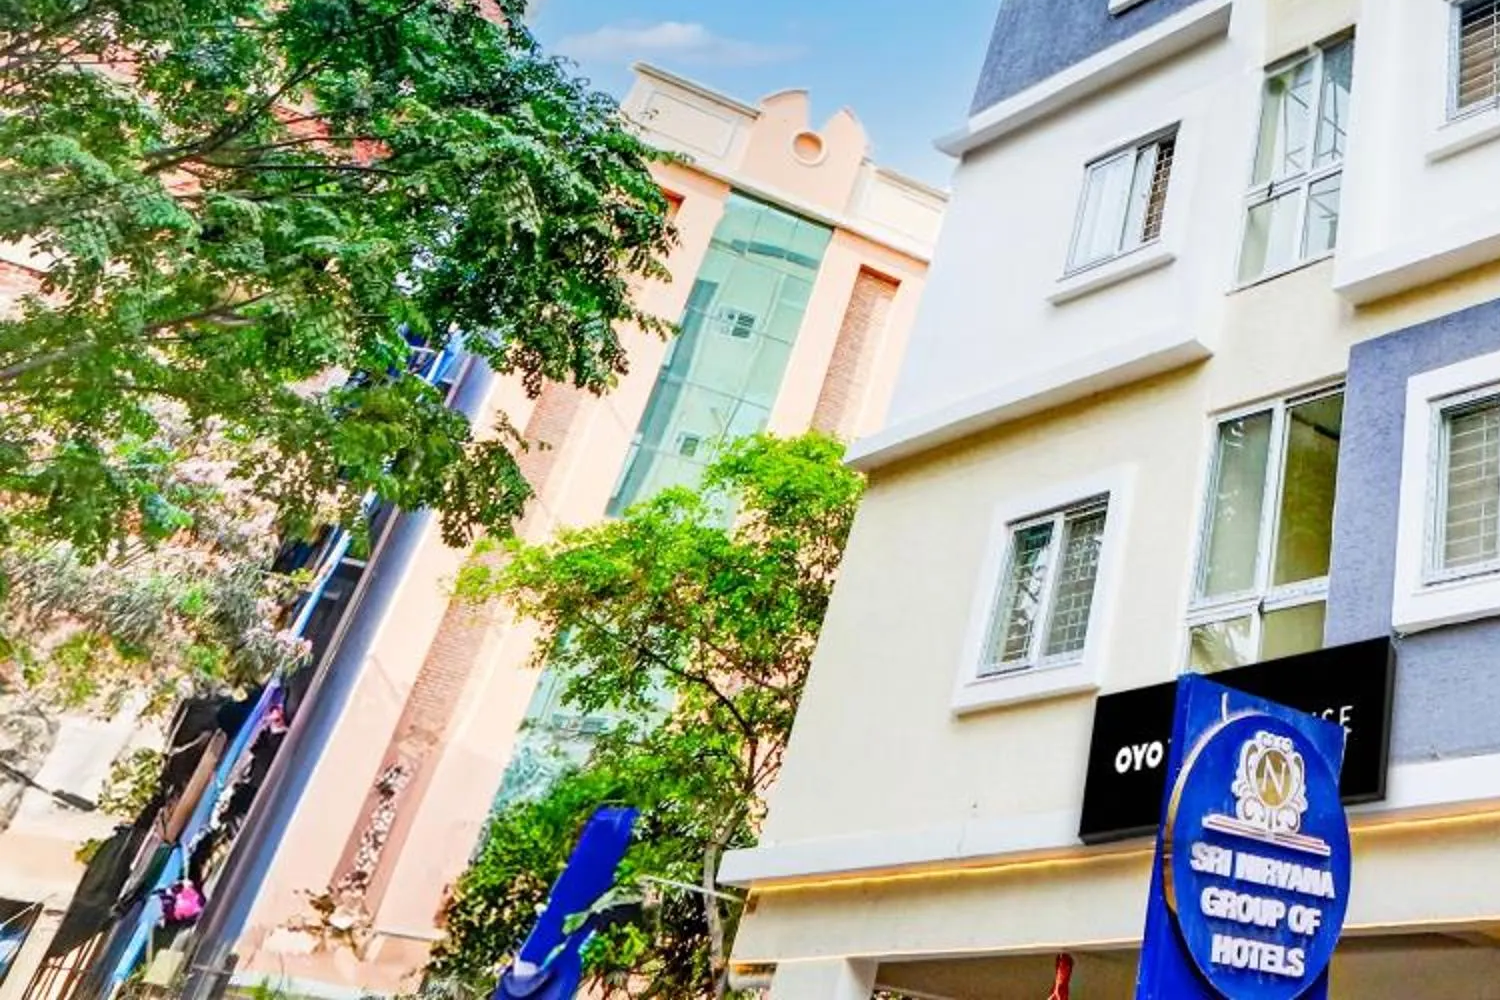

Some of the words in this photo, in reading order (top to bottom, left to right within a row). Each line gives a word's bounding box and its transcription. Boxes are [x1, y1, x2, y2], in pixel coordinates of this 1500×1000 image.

[1115, 740, 1163, 774] OYO
[1261, 755, 1287, 799] N
[1190, 842, 1233, 877] SRI
[1234, 851, 1336, 899] NIRVANA
[1201, 886, 1286, 927] GROUP
[1287, 904, 1322, 935] OF
[1210, 933, 1305, 978] HOTELS
